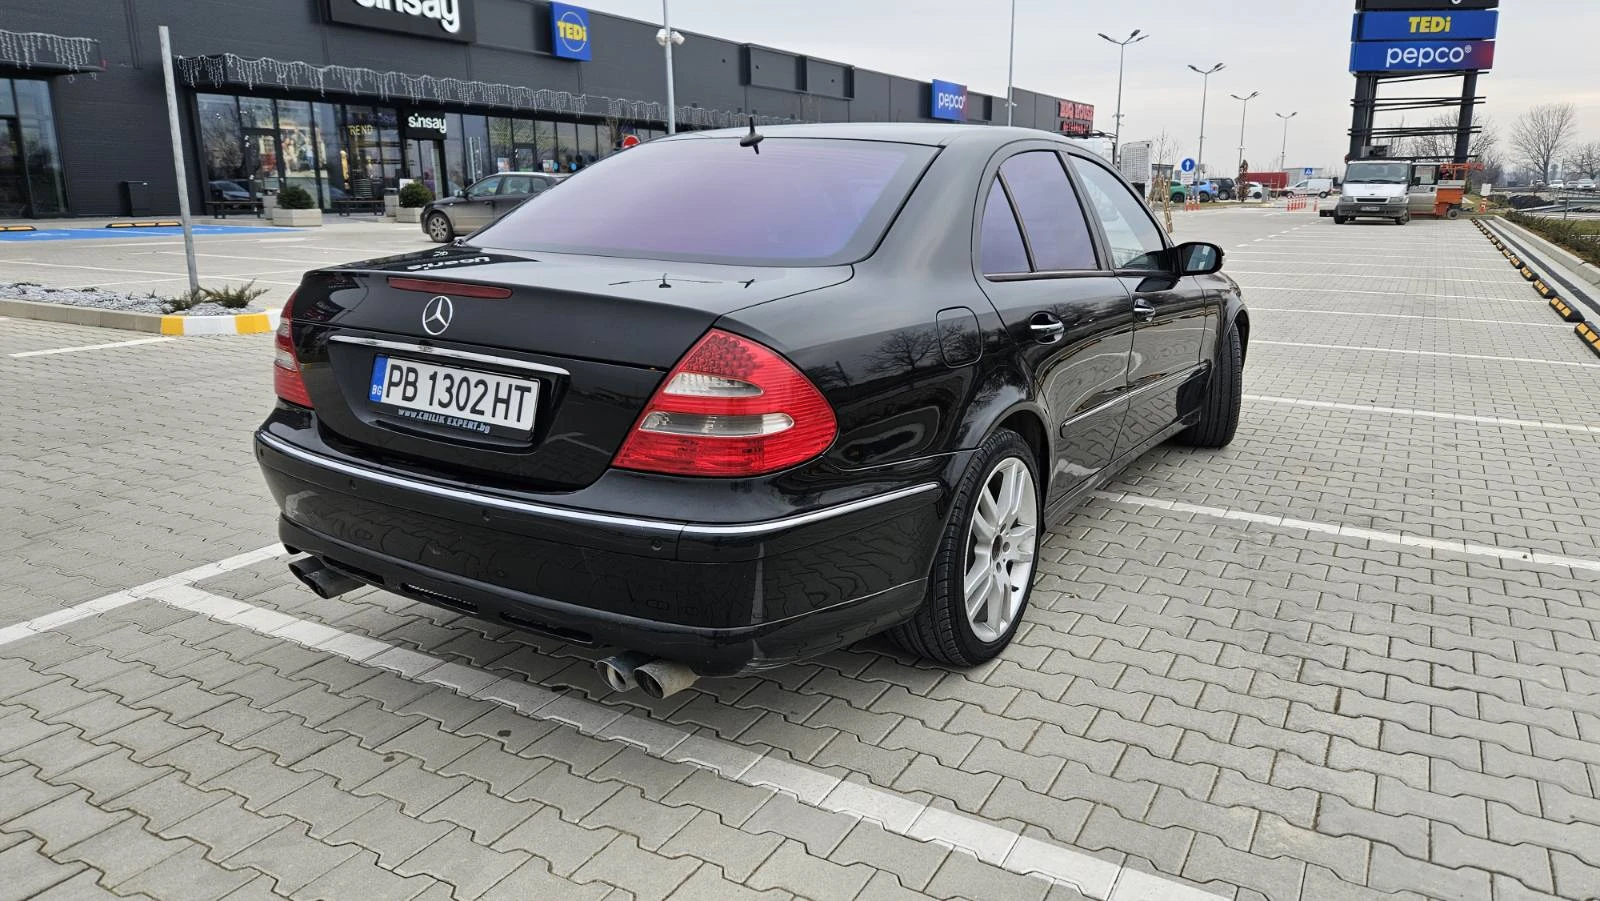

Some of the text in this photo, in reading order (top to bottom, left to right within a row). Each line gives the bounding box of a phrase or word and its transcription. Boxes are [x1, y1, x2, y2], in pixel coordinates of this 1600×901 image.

[557, 21, 587, 41] TEDi
[1408, 16, 1451, 33] TEDi
[408, 113, 447, 133] sinsay
[372, 385, 382, 396] BG
[386, 364, 532, 423] PB 1302 HT
